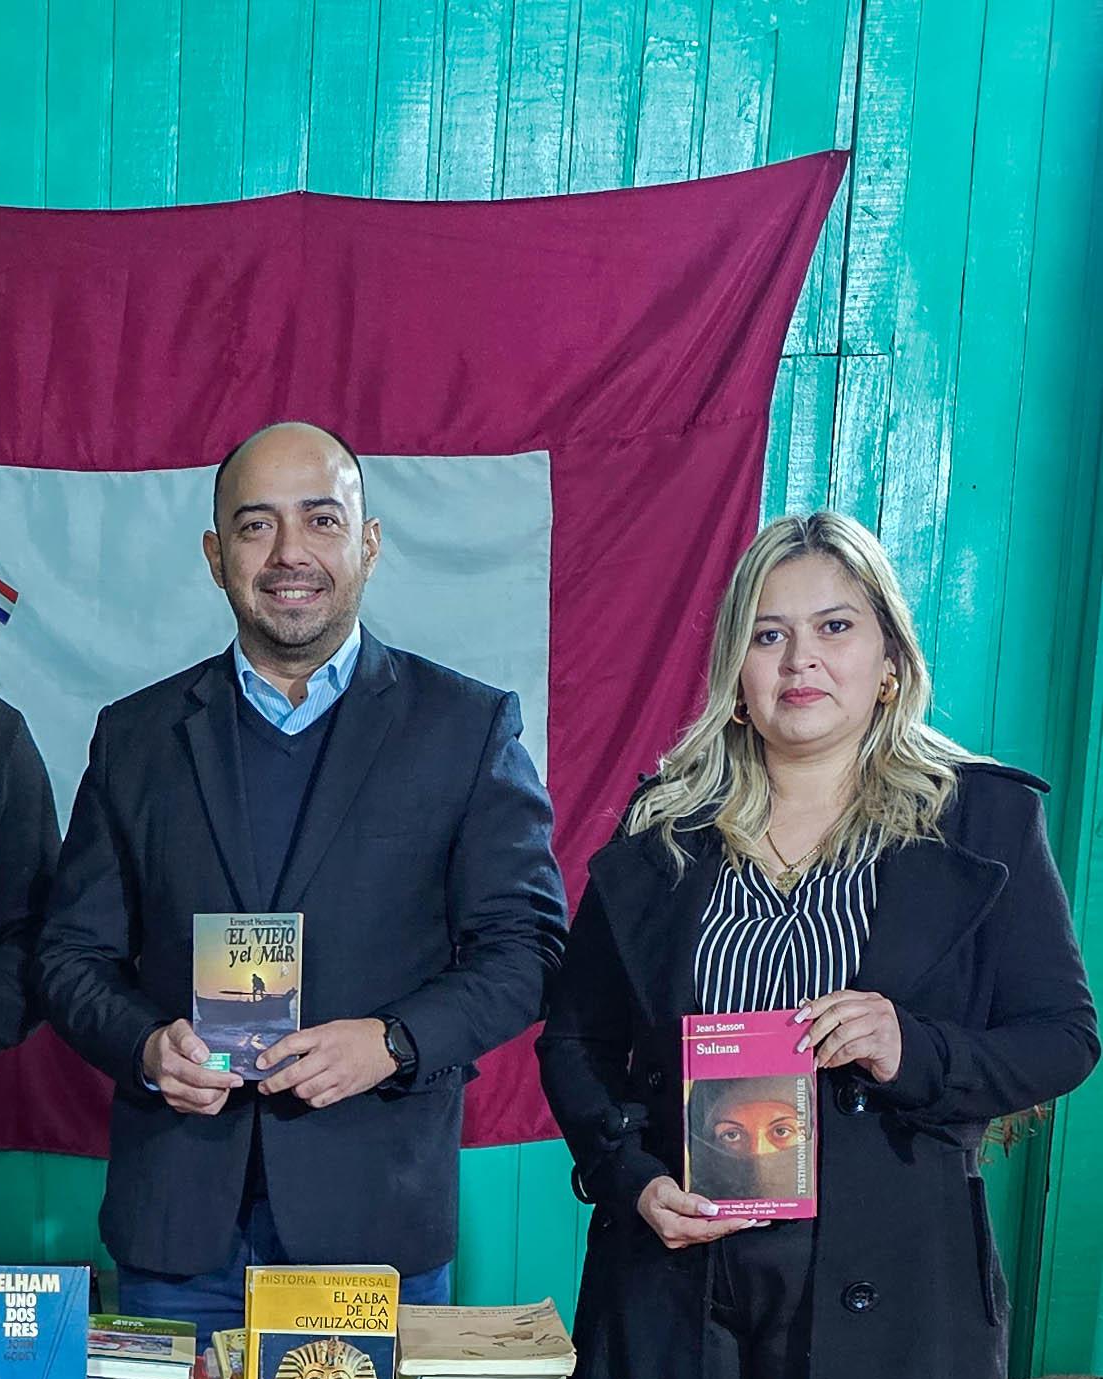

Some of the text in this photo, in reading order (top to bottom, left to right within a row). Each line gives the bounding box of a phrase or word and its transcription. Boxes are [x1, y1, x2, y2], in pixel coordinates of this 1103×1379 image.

[225, 927, 295, 949] EL VIEJO
[229, 950, 240, 967] y
[240, 945, 251, 963] el
[695, 1022, 745, 1034] Jean Sasson
[696, 1042, 740, 1055] Sultana
[797, 1112, 806, 1127] DE
[797, 1129, 807, 1195] TESTIMONIOS
[260, 1274, 391, 1288] HISTORIA UNIVERSAL
[5, 1293, 37, 1308] UNO
[333, 1291, 389, 1305] EL ALBA
[6, 1308, 36, 1323] DOS
[346, 1305, 389, 1317] DE LA
[2, 1323, 39, 1338] TRES
[295, 1316, 389, 1330] CIVILIZACION
